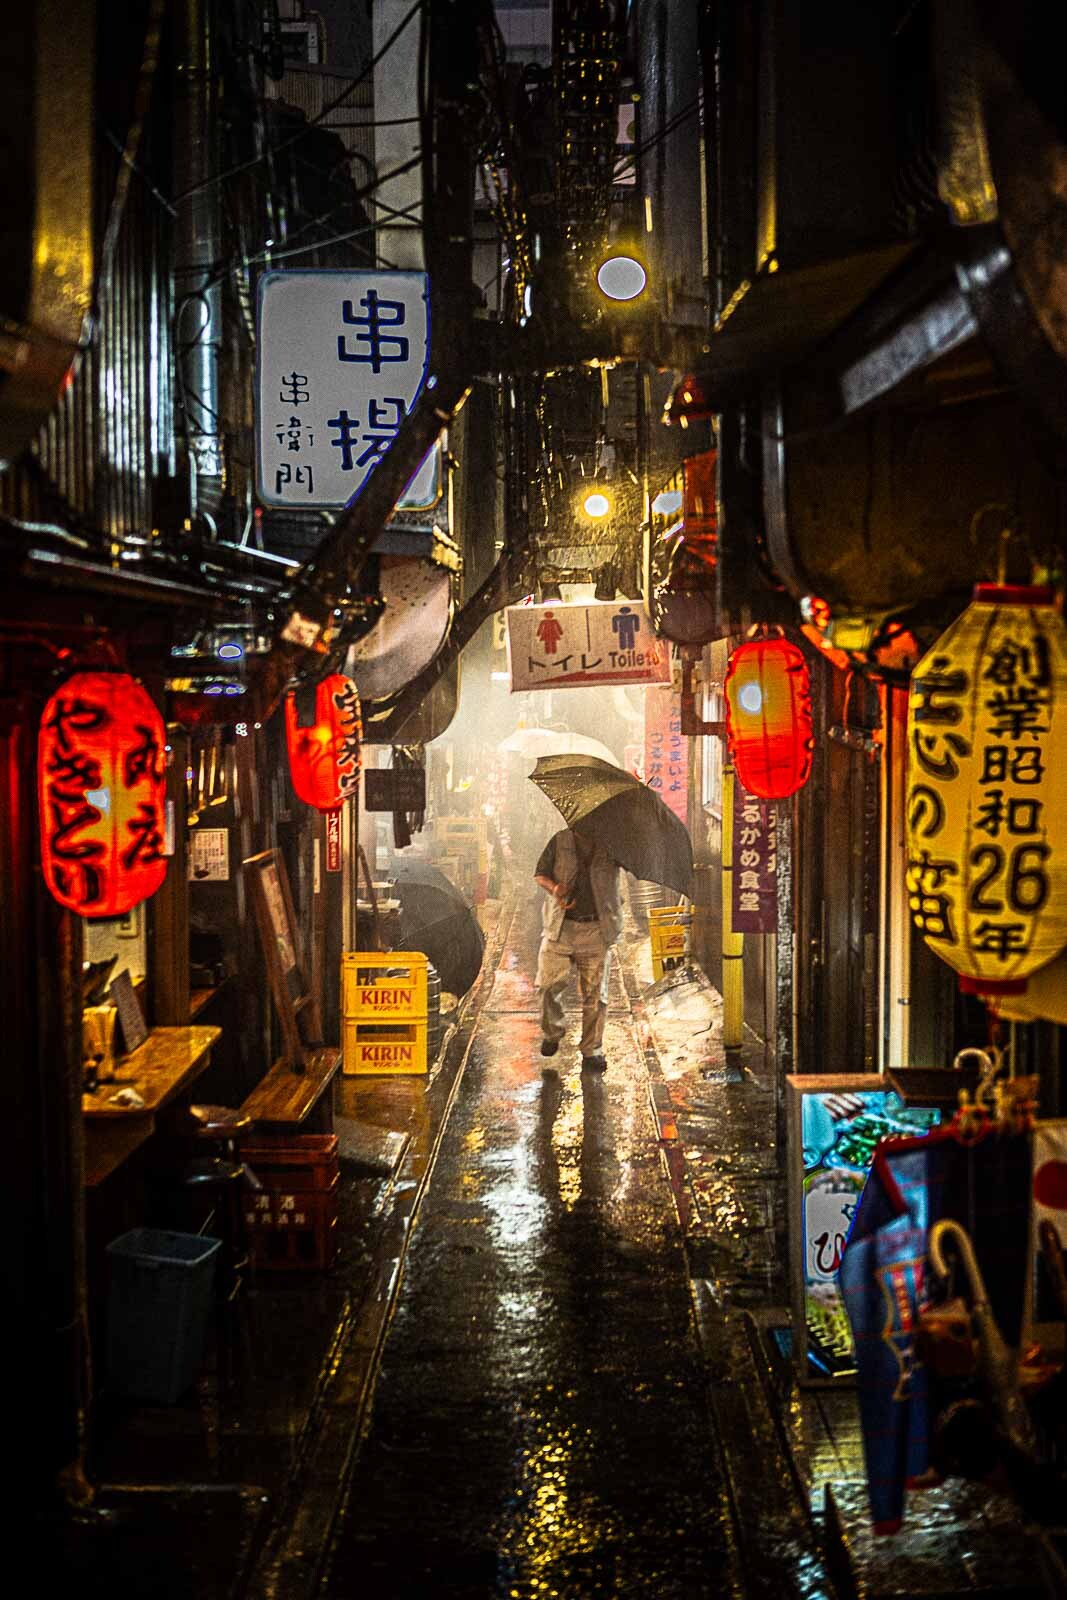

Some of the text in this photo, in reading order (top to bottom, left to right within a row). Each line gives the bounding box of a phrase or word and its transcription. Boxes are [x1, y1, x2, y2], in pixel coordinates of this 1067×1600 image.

[275, 371, 315, 494] 串衛門
[528, 654, 603, 672] トイレ
[968, 635, 1051, 962] 創業昭和26年
[739, 795, 762, 911] るかめ食堂
[361, 990, 412, 1004] KIRIN
[361, 1047, 412, 1061] KIRIN
